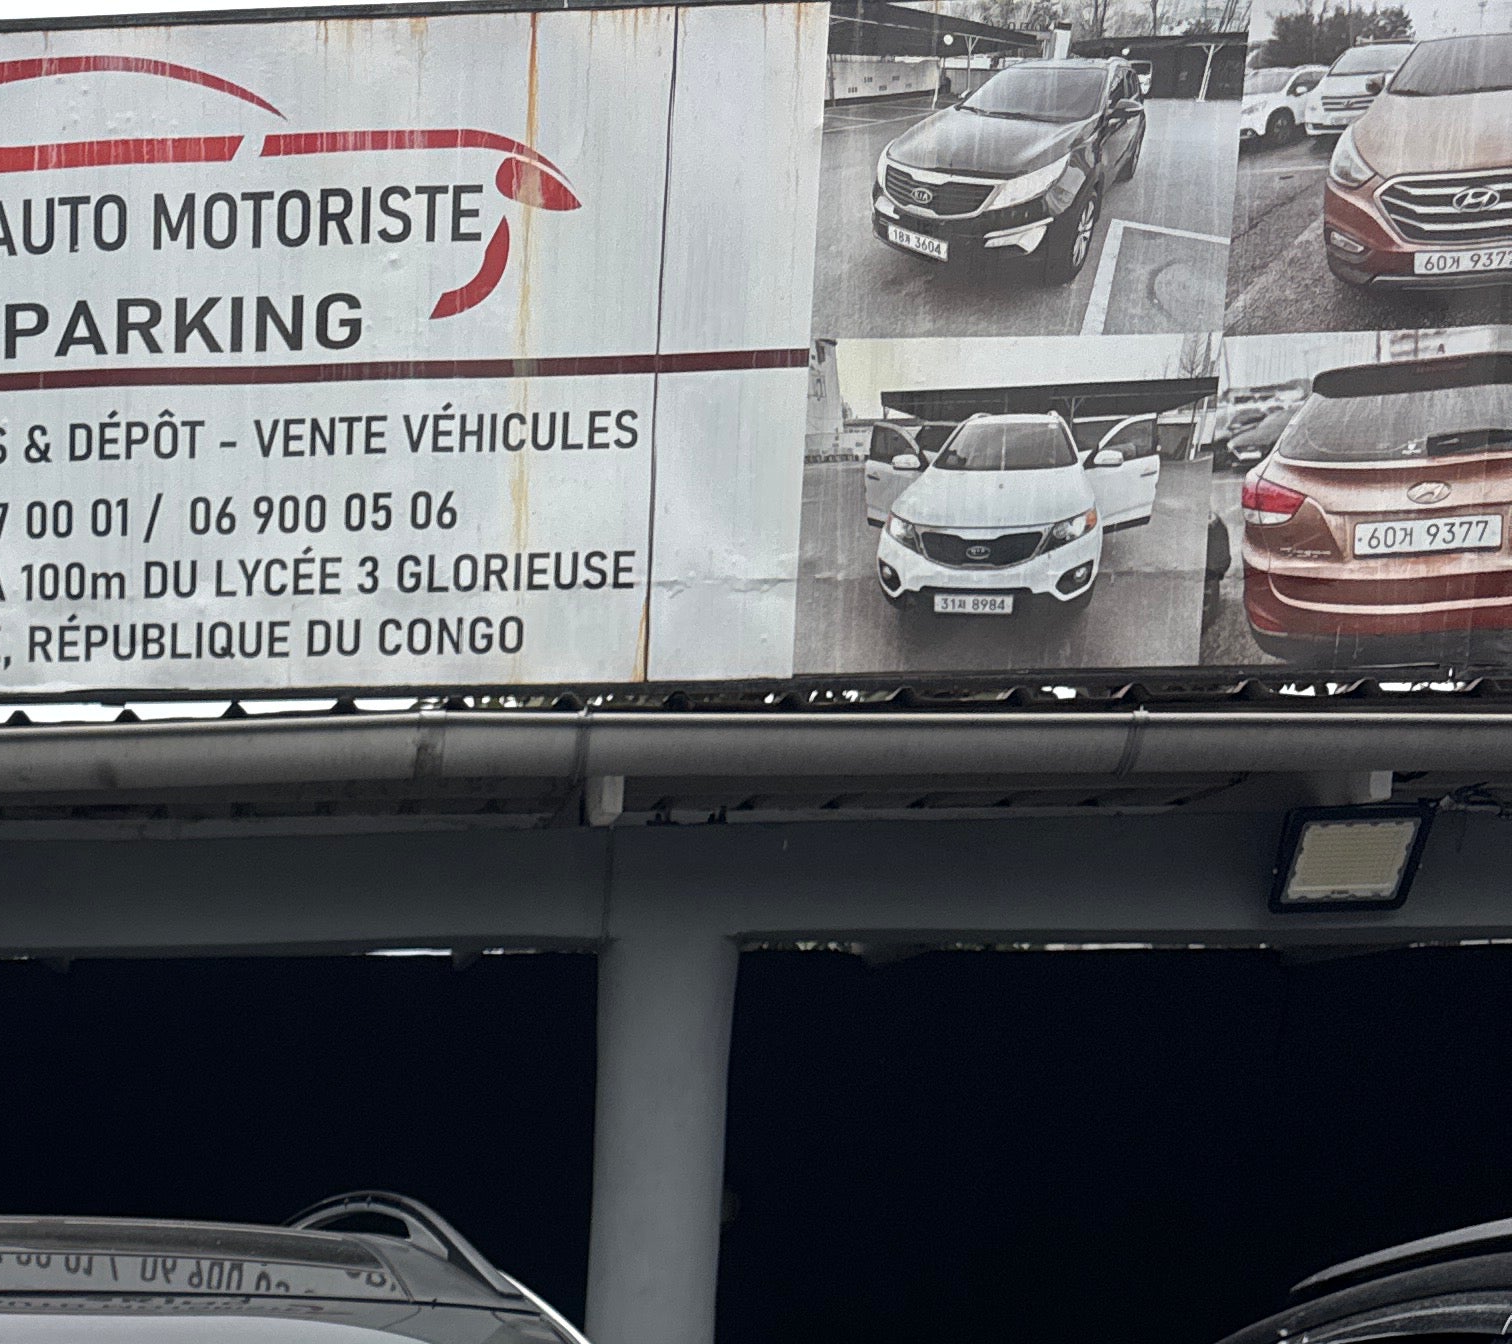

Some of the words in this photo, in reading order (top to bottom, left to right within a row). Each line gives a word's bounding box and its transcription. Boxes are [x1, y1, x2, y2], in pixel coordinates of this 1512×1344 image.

[153, 184, 483, 250] MOTORISTE
[915, 236, 942, 256] 3604
[5, 293, 362, 359] PARKING
[24, 425, 52, 463] &
[69, 409, 205, 461] DÉPÔT
[254, 415, 387, 457] VENTE
[403, 402, 638, 452] VÉHICULES
[27, 500, 73, 539] 00
[91, 498, 128, 537] 01
[143, 493, 163, 543] /
[190, 497, 236, 535] 06
[254, 495, 326, 534] 900
[345, 492, 392, 531] 05
[411, 491, 457, 530] 06
[1426, 520, 1489, 545] 9377
[22, 562, 125, 601] 100m
[144, 560, 197, 599] DU
[216, 546, 342, 597] LYCÉE
[358, 556, 378, 594] 3
[398, 551, 635, 593] GLORIEUSE
[972, 598, 1005, 611] 8984
[29, 614, 290, 662] RÉPUBLIQUE
[307, 619, 360, 657] DU
[379, 616, 523, 656] CONGO
